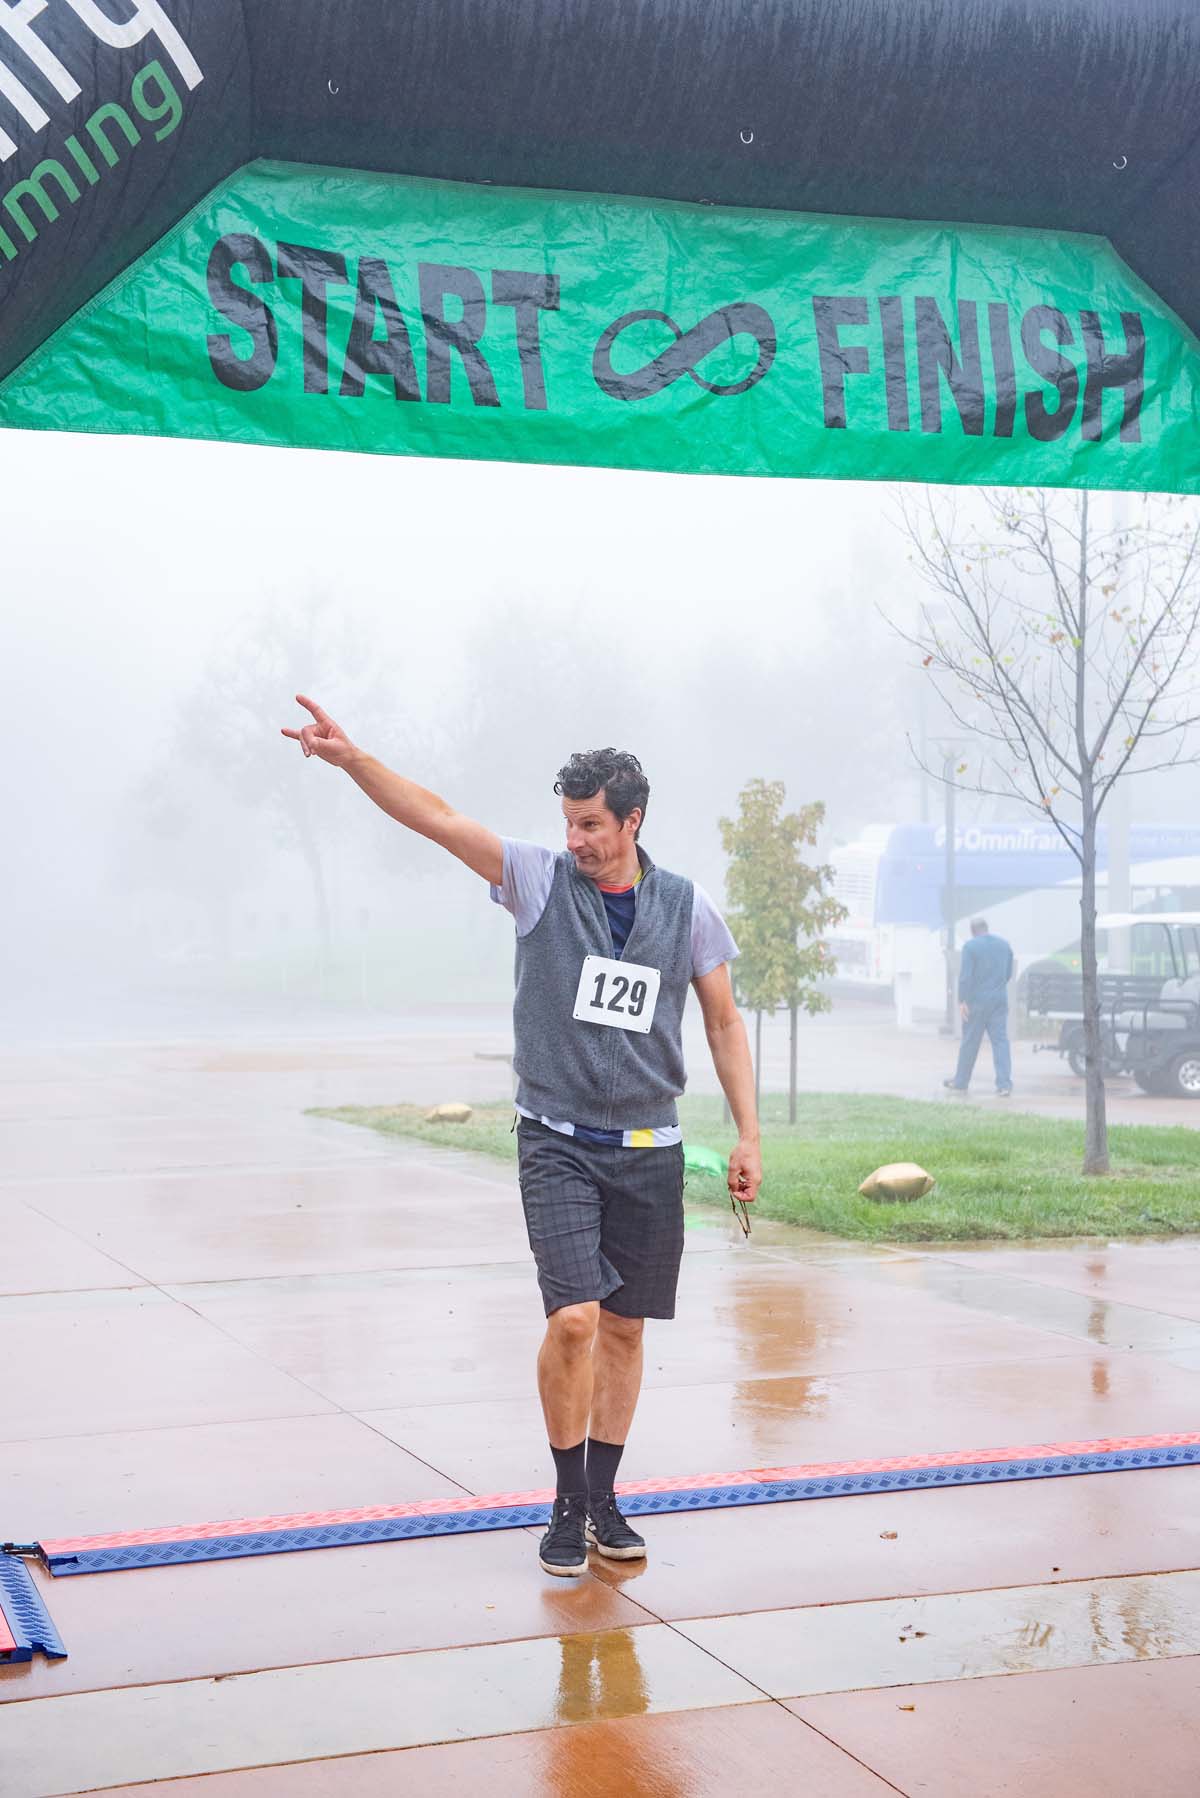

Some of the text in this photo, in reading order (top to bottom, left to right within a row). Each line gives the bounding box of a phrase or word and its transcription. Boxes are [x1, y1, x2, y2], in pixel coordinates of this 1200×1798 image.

[0, 59, 183, 269] iming
[206, 233, 1146, 443] START FINISH
[589, 972, 648, 1017] 129
